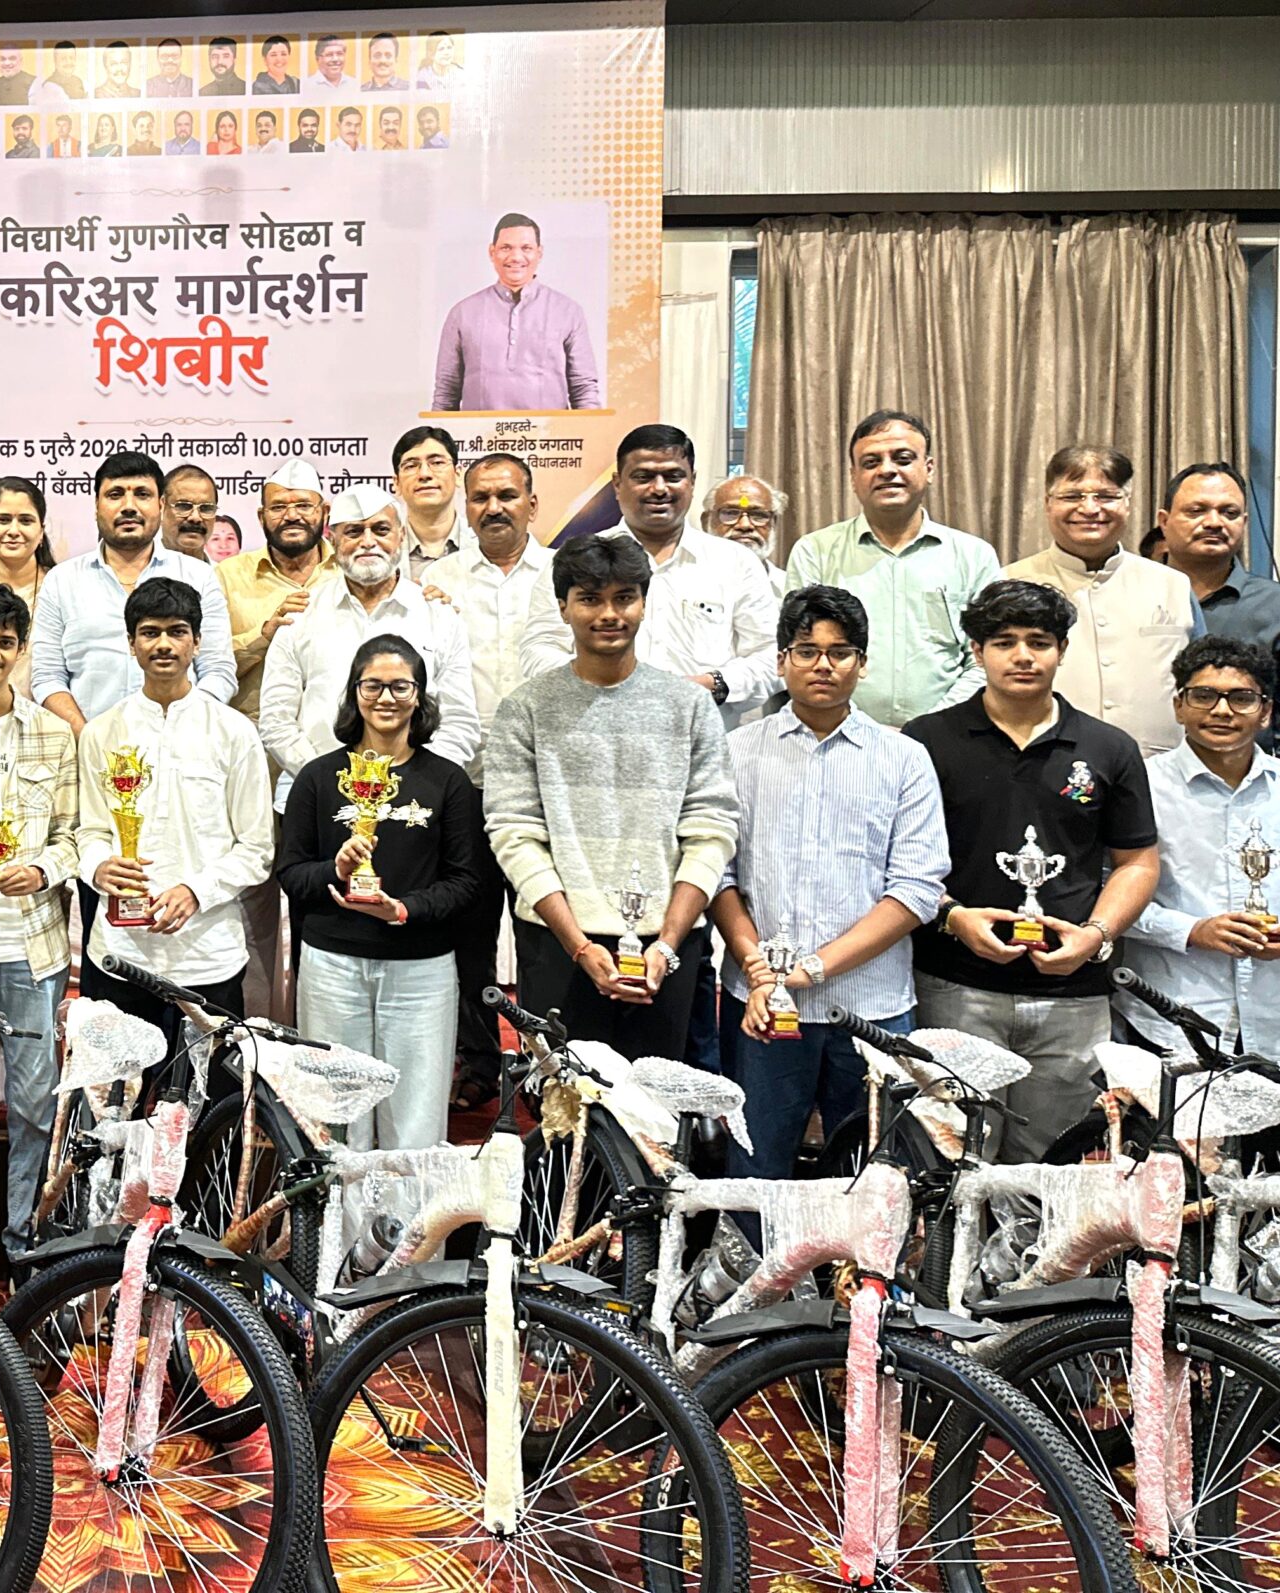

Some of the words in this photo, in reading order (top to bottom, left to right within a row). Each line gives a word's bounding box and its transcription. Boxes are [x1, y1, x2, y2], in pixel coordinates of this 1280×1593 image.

[0, 215, 102, 253] विद्यार्थी
[108, 213, 230, 262] गुणगौरव
[240, 212, 333, 252] सोहळा
[344, 220, 366, 248] व
[175, 254, 368, 320] मार्गदर्शन
[93, 315, 269, 387] शिबीर
[23, 439, 35, 458] 5
[39, 432, 76, 465] जुलै
[132, 432, 175, 458] रोजी
[178, 432, 247, 457] सकाळी
[252, 438, 304, 457] 10.00
[308, 437, 369, 457] वाजता
[527, 454, 583, 469] विधानसभा
[539, 438, 584, 452] जगताप
[51, 469, 96, 496] बँक्वे
[215, 470, 267, 496] गार्डन
